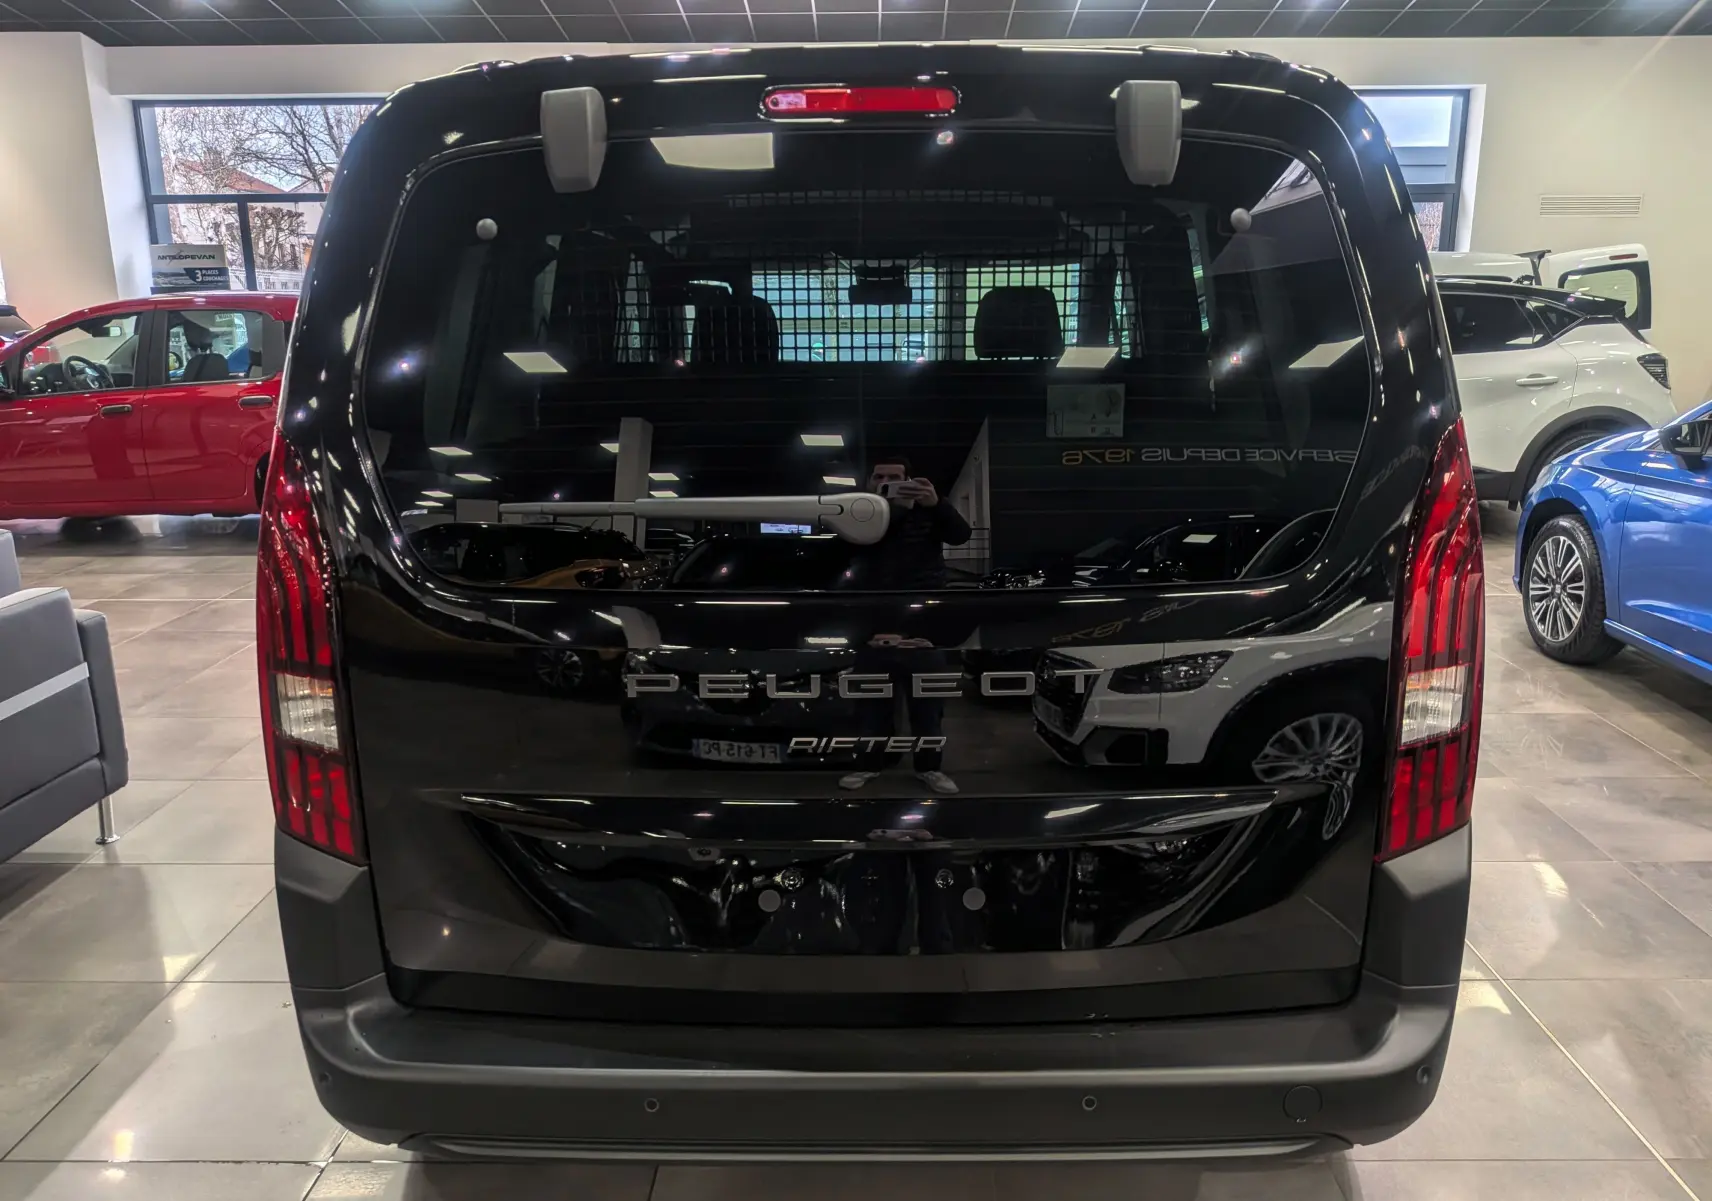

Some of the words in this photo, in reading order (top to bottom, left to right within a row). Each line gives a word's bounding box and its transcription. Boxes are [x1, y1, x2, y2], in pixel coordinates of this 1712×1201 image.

[195, 270, 202, 281] 3
[626, 669, 1104, 698] PEUGEOT
[787, 736, 947, 754] RIFTER
